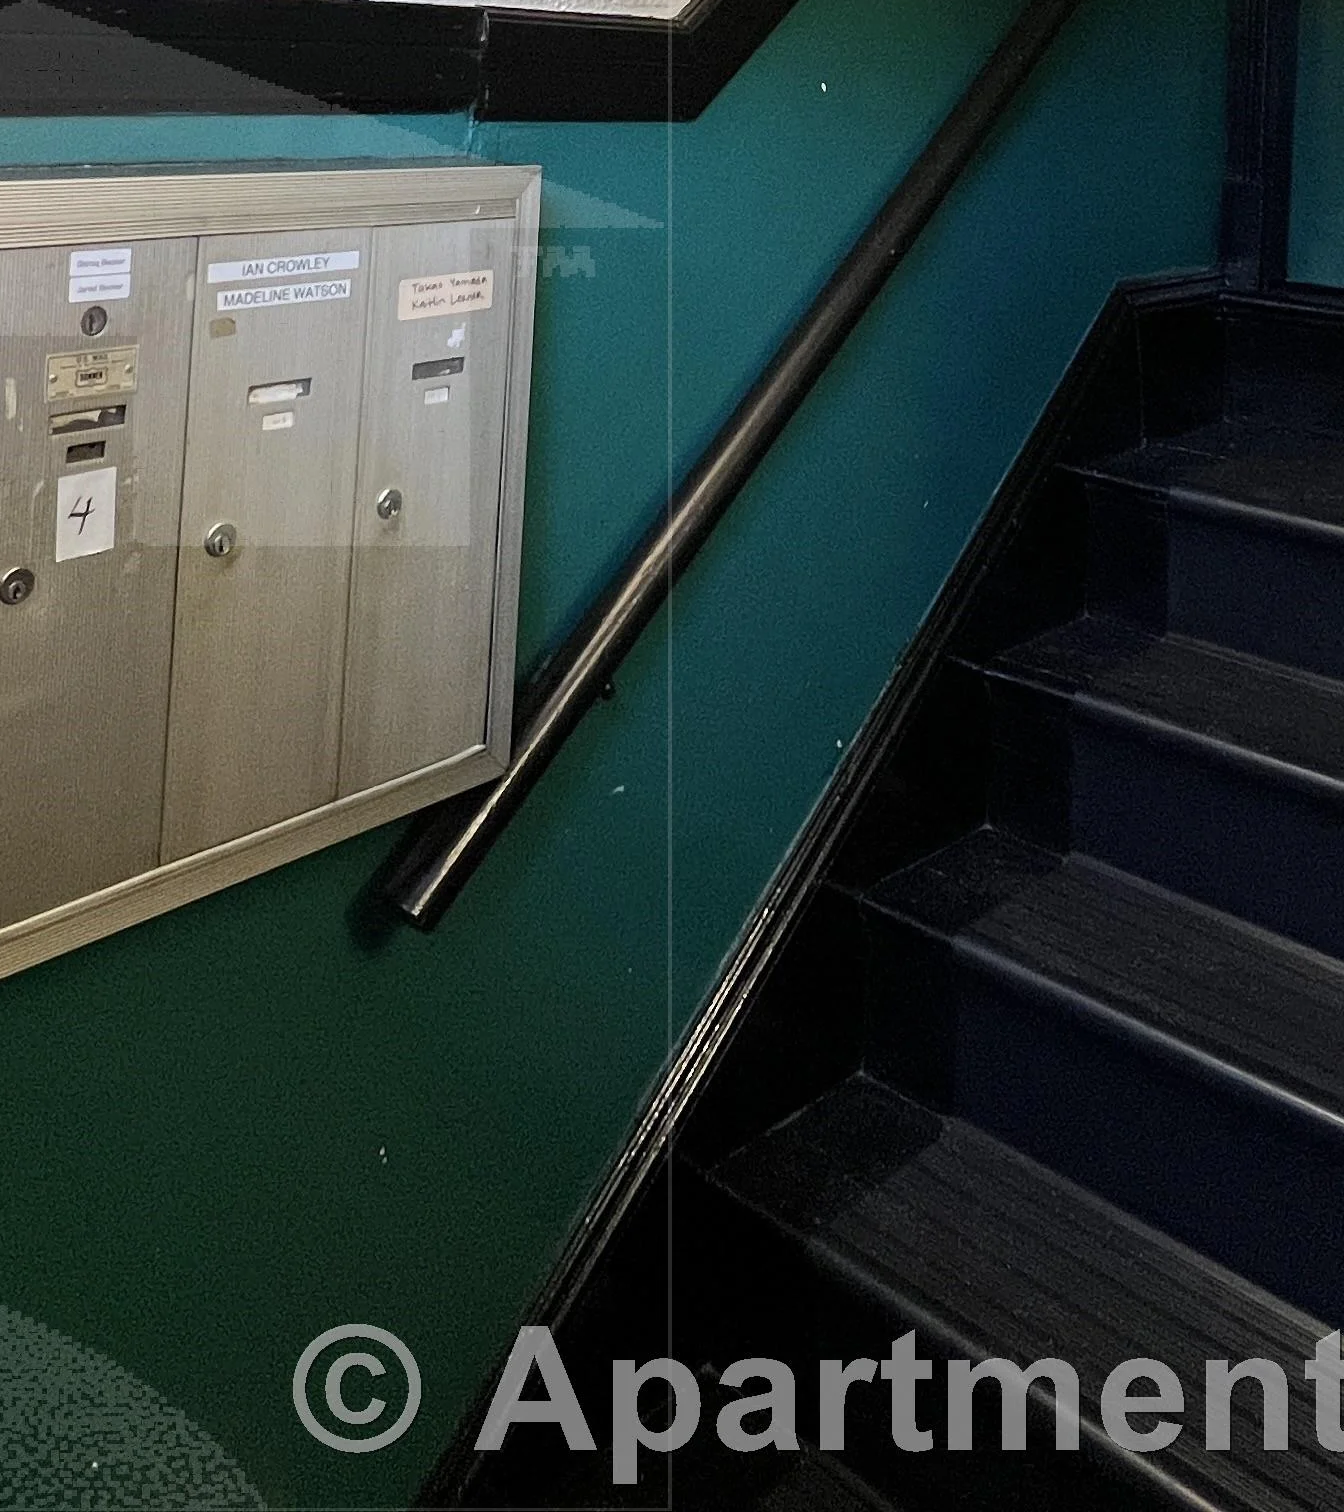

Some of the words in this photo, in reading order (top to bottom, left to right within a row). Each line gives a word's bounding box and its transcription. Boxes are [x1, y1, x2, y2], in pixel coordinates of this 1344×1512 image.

[241, 263, 264, 276] IAN
[266, 257, 331, 274] CROWLEY
[223, 290, 290, 307] MADELINE
[293, 283, 348, 299] WATSON
[67, 495, 96, 536] 4
